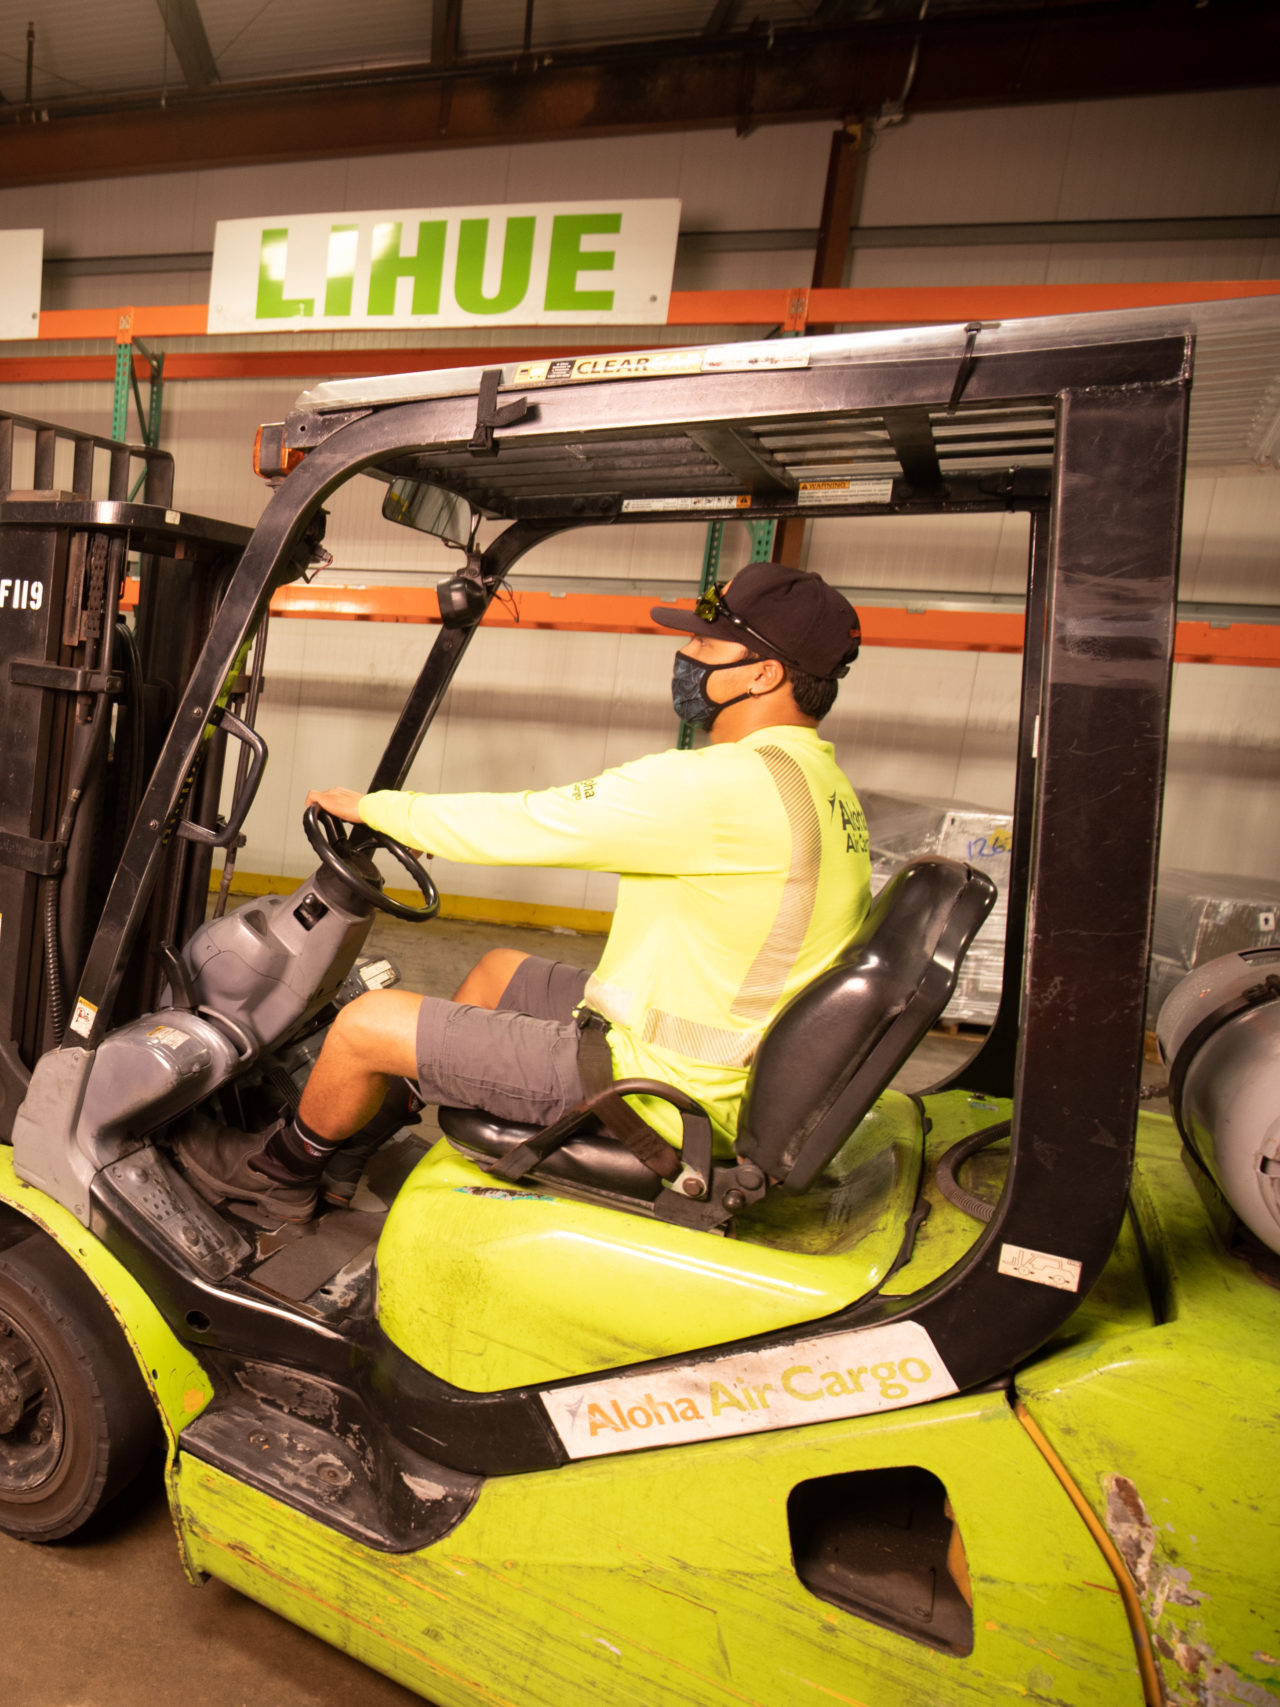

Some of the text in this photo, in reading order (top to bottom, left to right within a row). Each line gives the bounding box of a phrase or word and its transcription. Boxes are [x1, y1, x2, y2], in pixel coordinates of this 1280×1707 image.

[255, 213, 623, 319] LIHUE
[968, 837, 1012, 861] 126
[588, 1357, 932, 1437] Aloha Air Cargo
